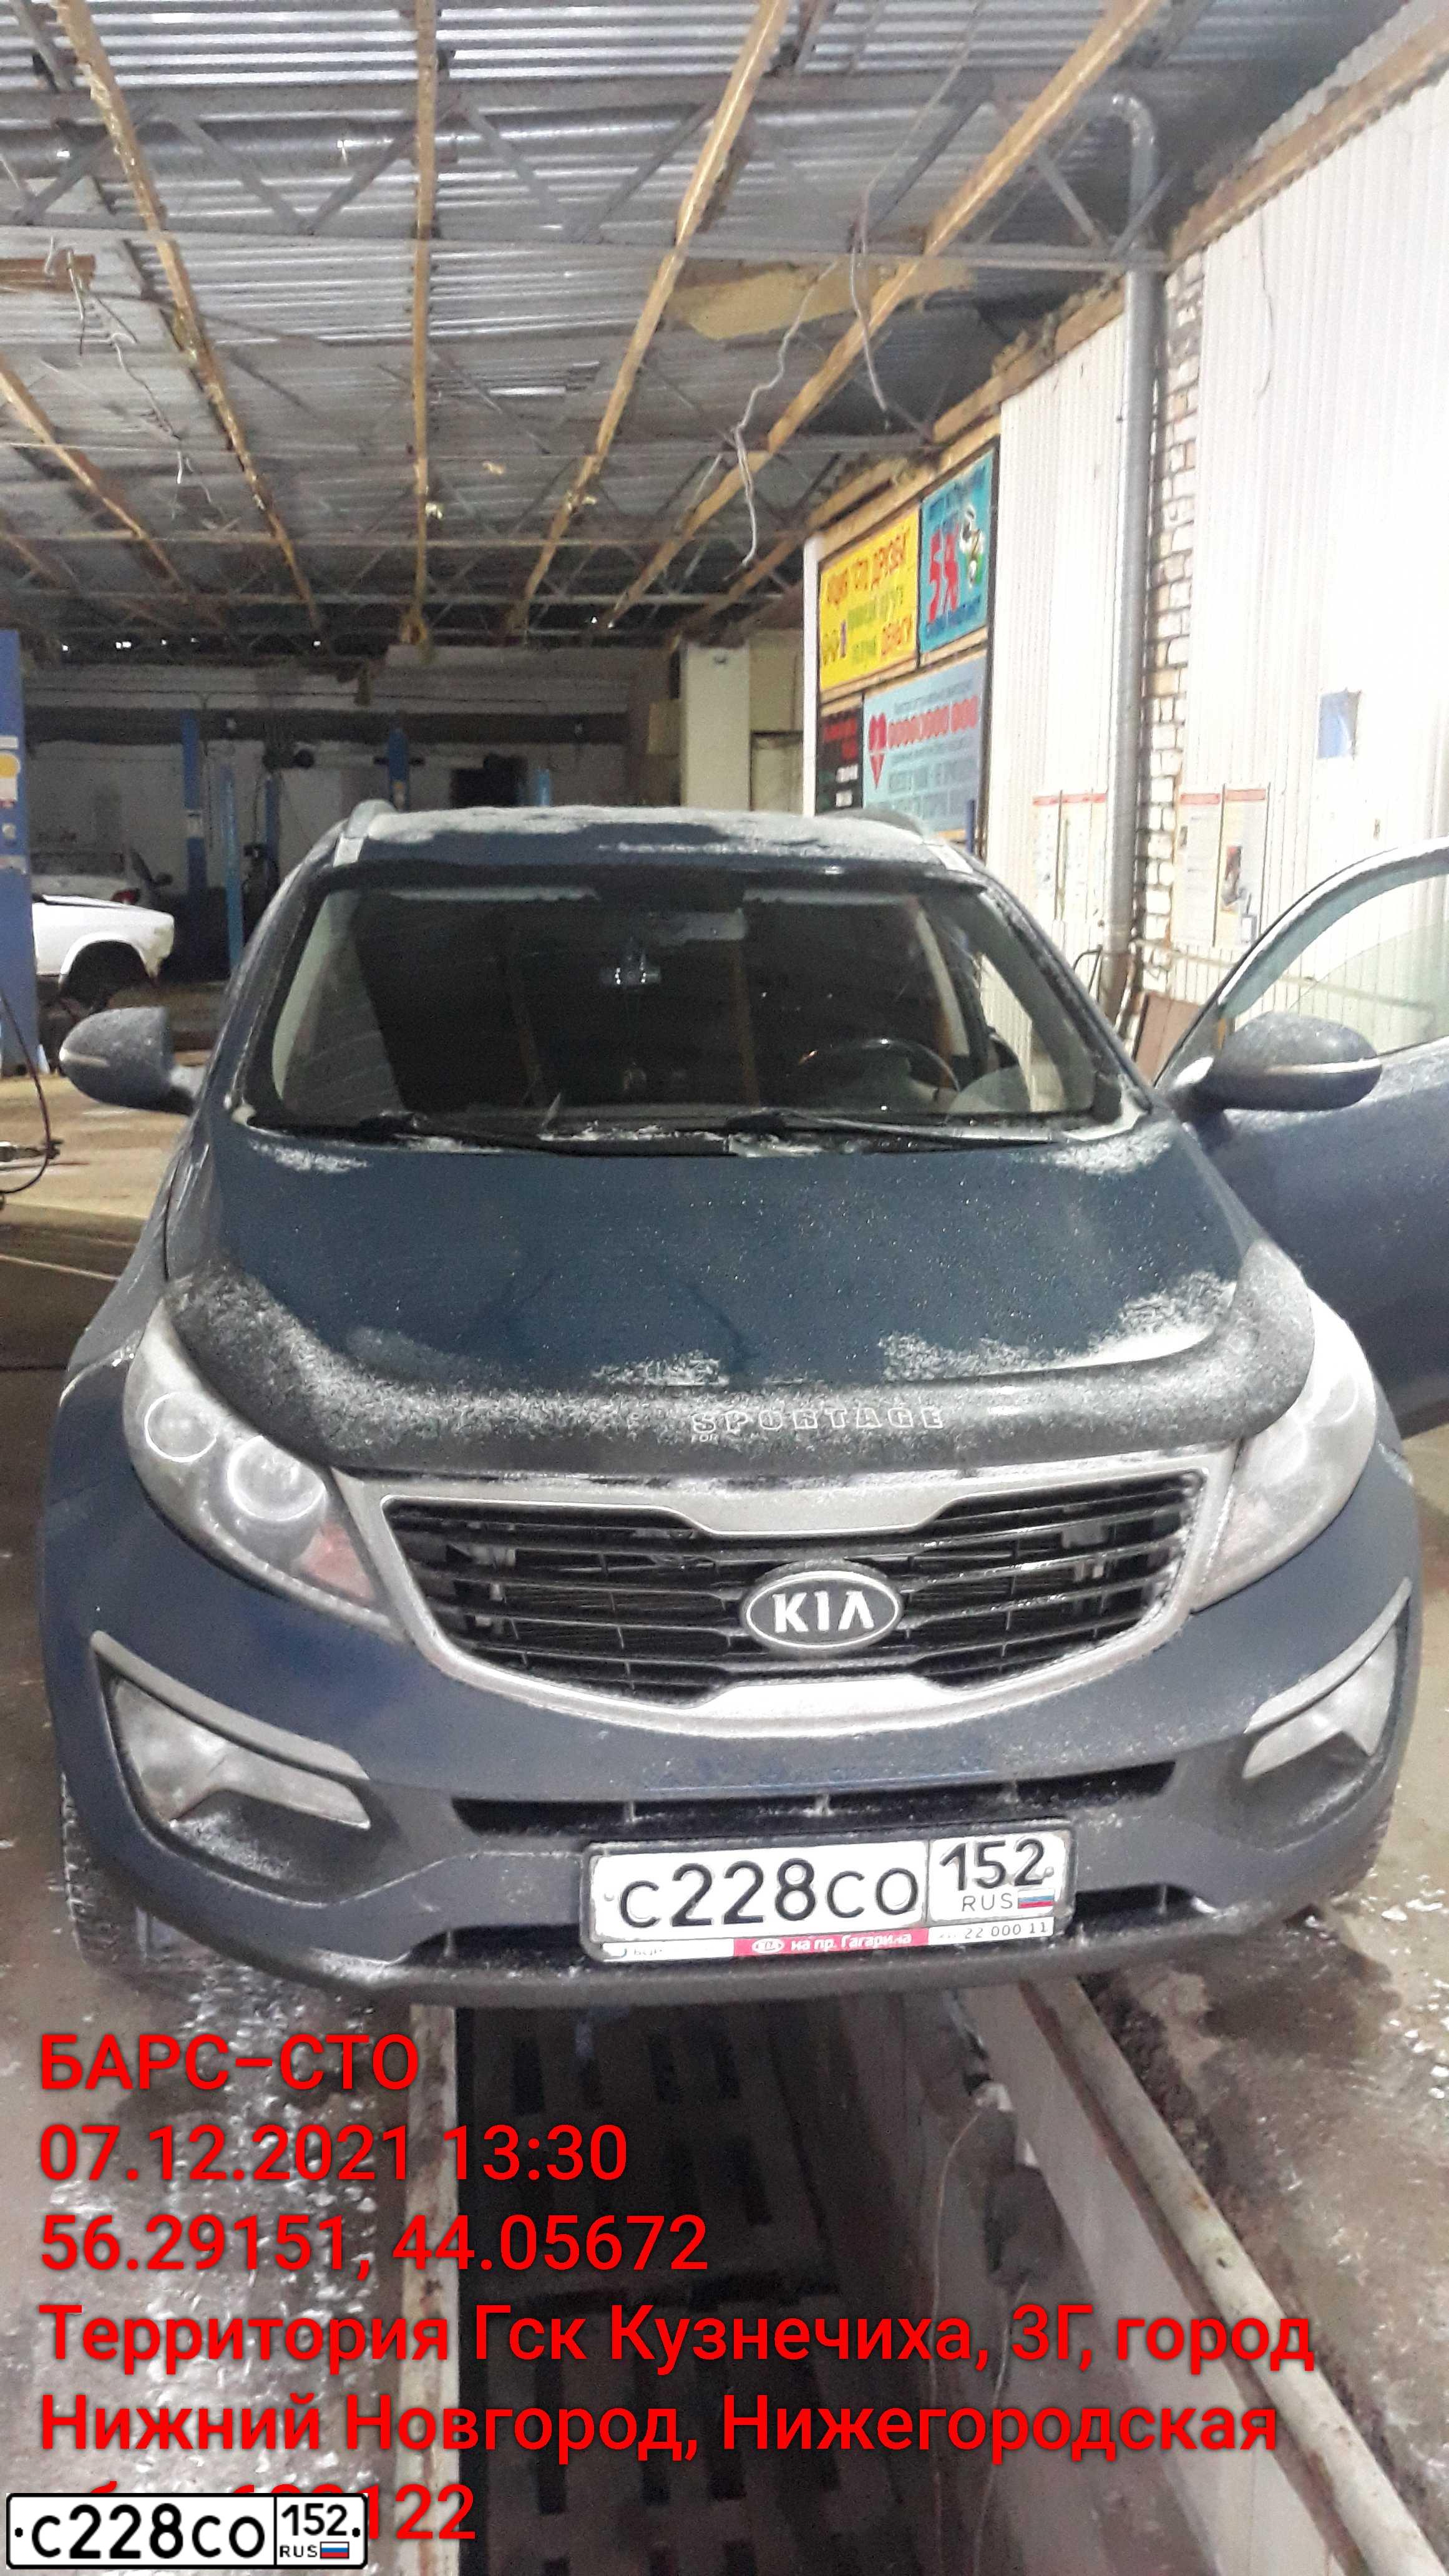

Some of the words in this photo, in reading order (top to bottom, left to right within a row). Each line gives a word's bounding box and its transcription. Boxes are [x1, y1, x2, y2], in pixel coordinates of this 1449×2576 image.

[692, 1407, 944, 1433] SPORTAGE
[772, 1591, 874, 1633] KIA
[619, 1857, 919, 1928] С228СО
[939, 1838, 1044, 1890] 152
[962, 1893, 1013, 1911] RUS
[991, 1924, 1022, 1938] 000
[1029, 1921, 1048, 1934] 11
